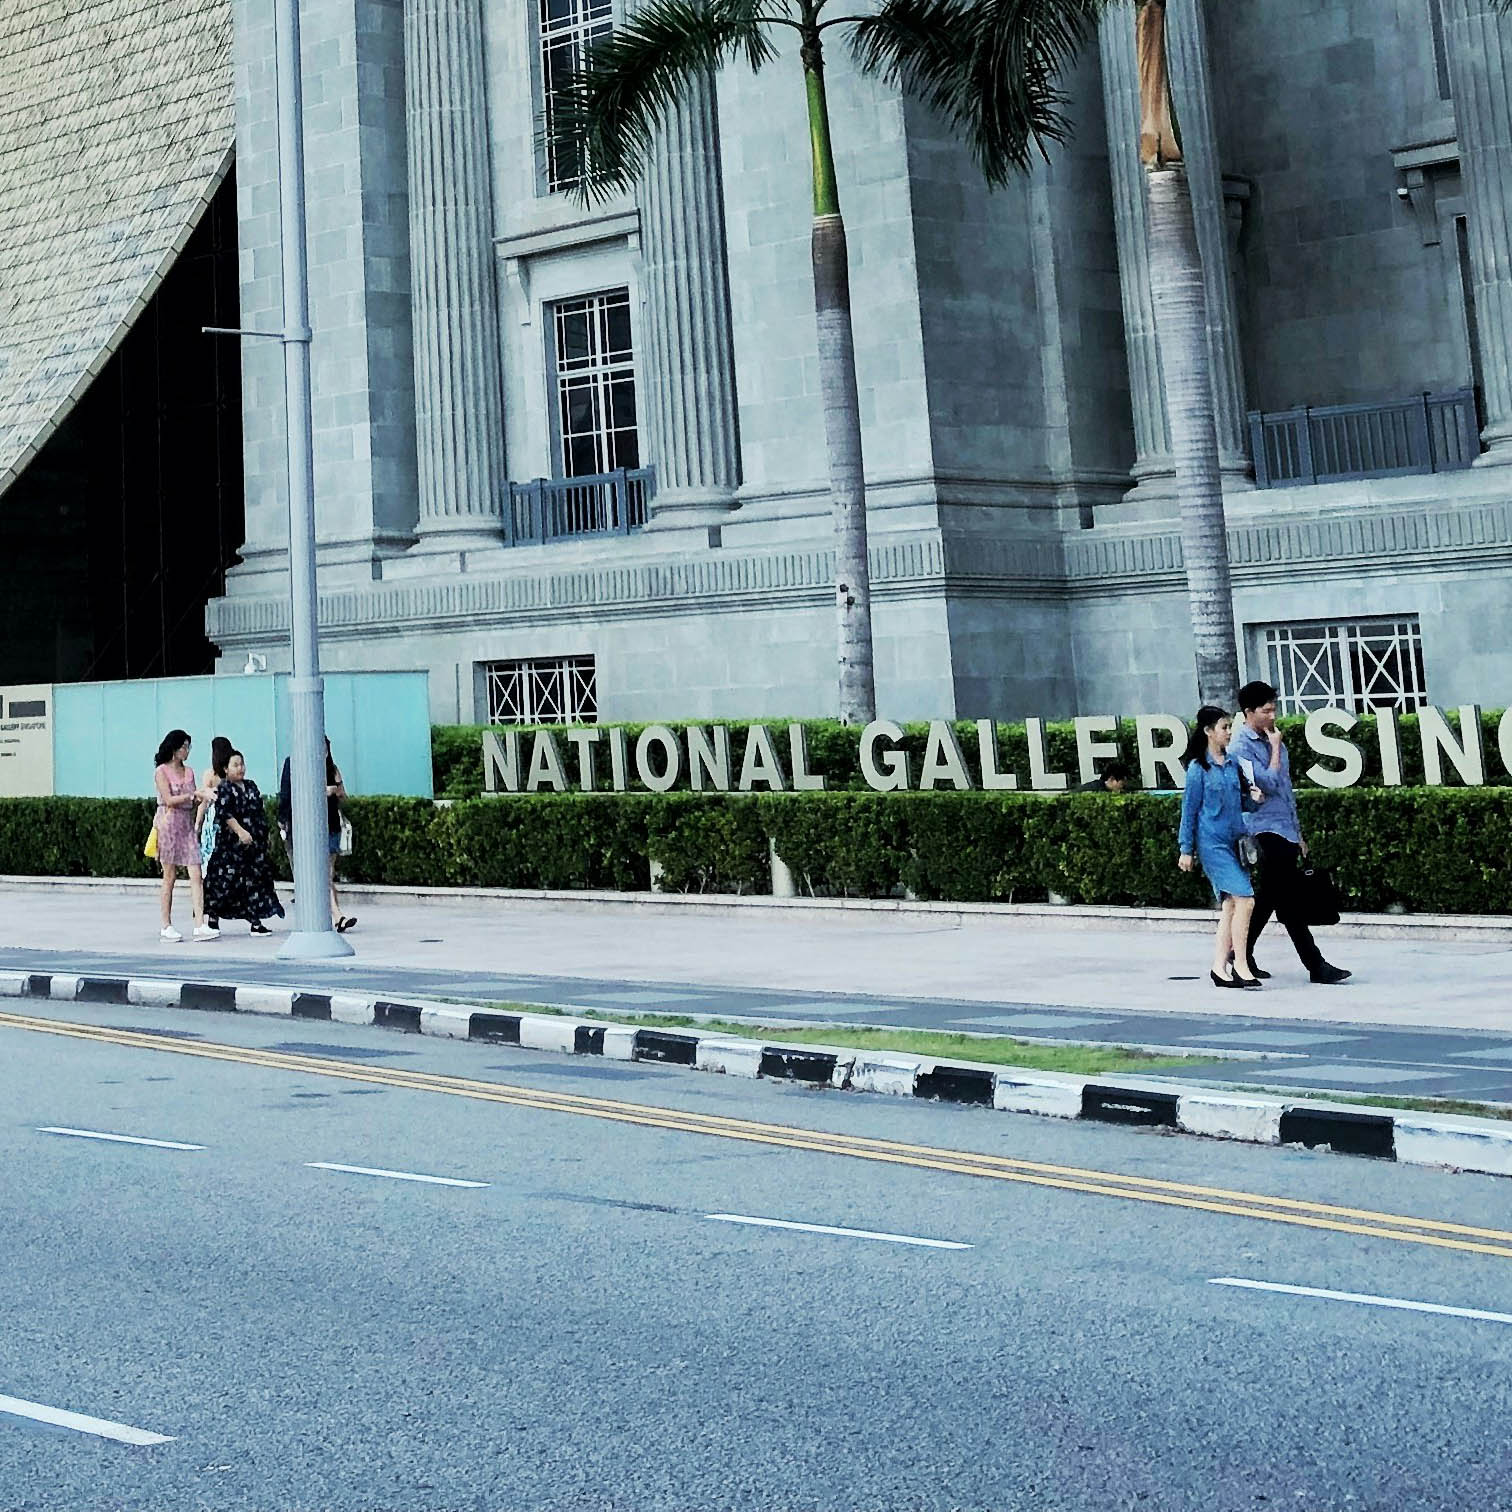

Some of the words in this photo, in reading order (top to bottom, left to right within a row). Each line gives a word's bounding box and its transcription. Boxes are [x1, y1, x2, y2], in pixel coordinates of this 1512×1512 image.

[482, 724, 826, 792] NATIONAL
[859, 712, 1245, 792] GALLER
[1304, 704, 1512, 789] SIN
